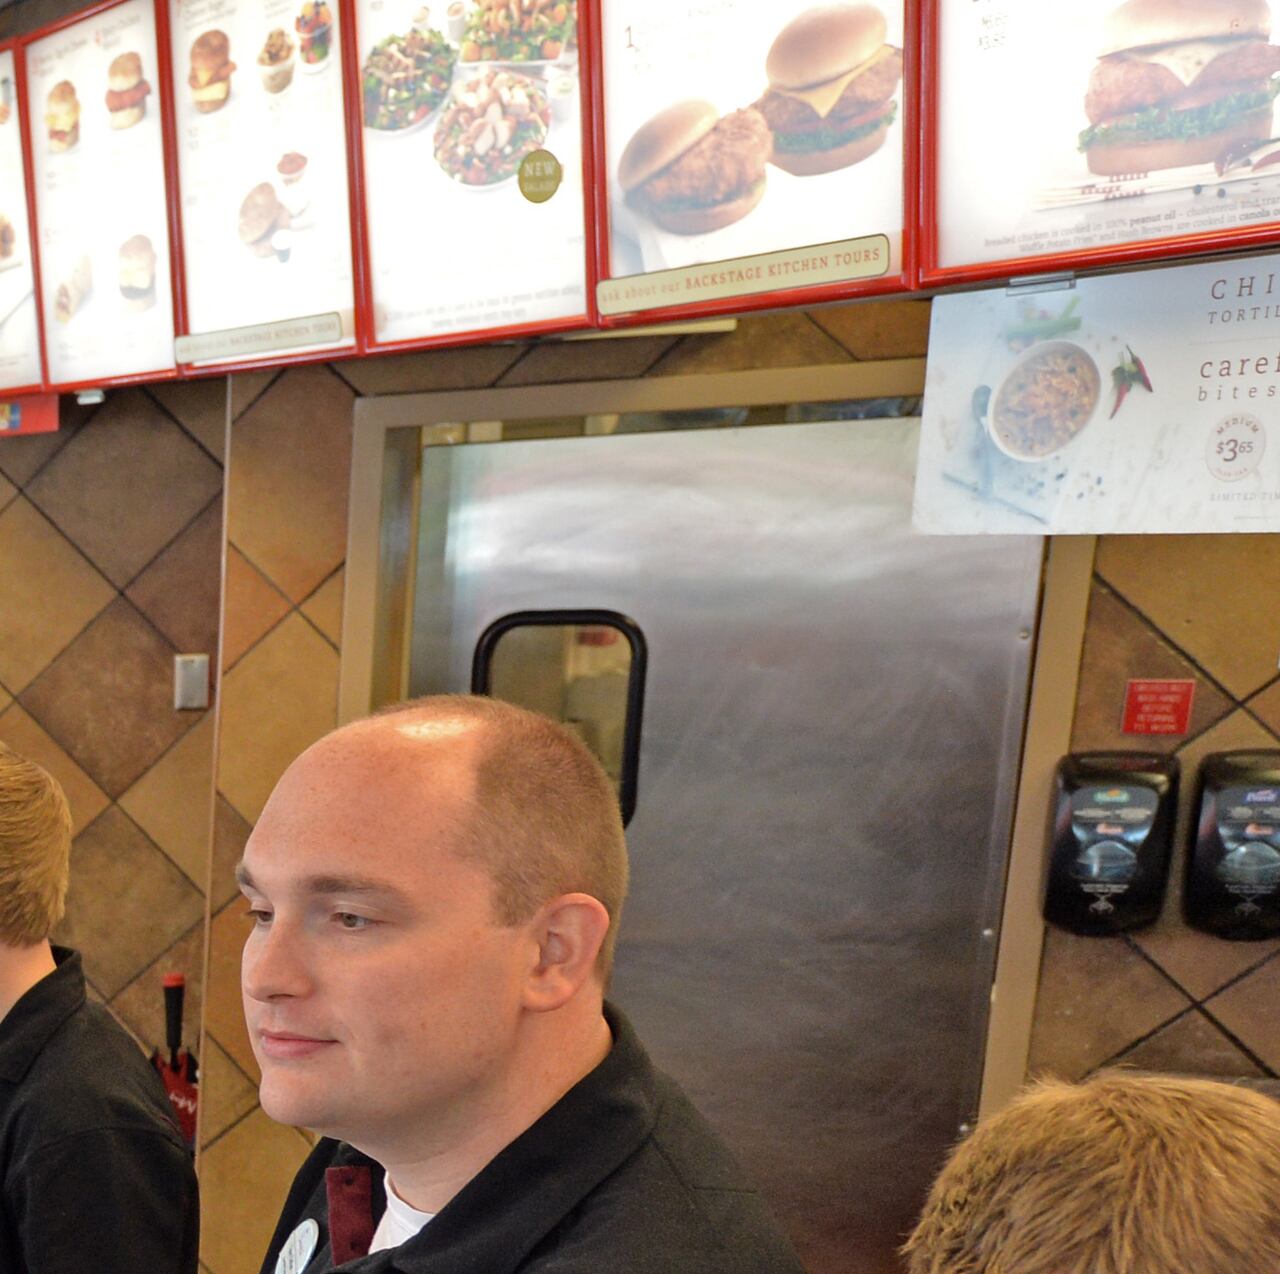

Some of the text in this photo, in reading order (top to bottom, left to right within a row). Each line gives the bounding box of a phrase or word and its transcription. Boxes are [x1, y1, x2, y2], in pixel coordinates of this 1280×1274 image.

[524, 160, 555, 176] NEW
[1129, 213, 1162, 227] peanut
[1164, 209, 1176, 220] oil
[685, 266, 762, 290] BACKSTAGE
[767, 255, 828, 278] KITCHEN
[834, 247, 882, 267] TOURS
[1211, 273, 1275, 300] CHI
[1208, 304, 1280, 324] TORTIL
[1198, 384, 1276, 402] bites
